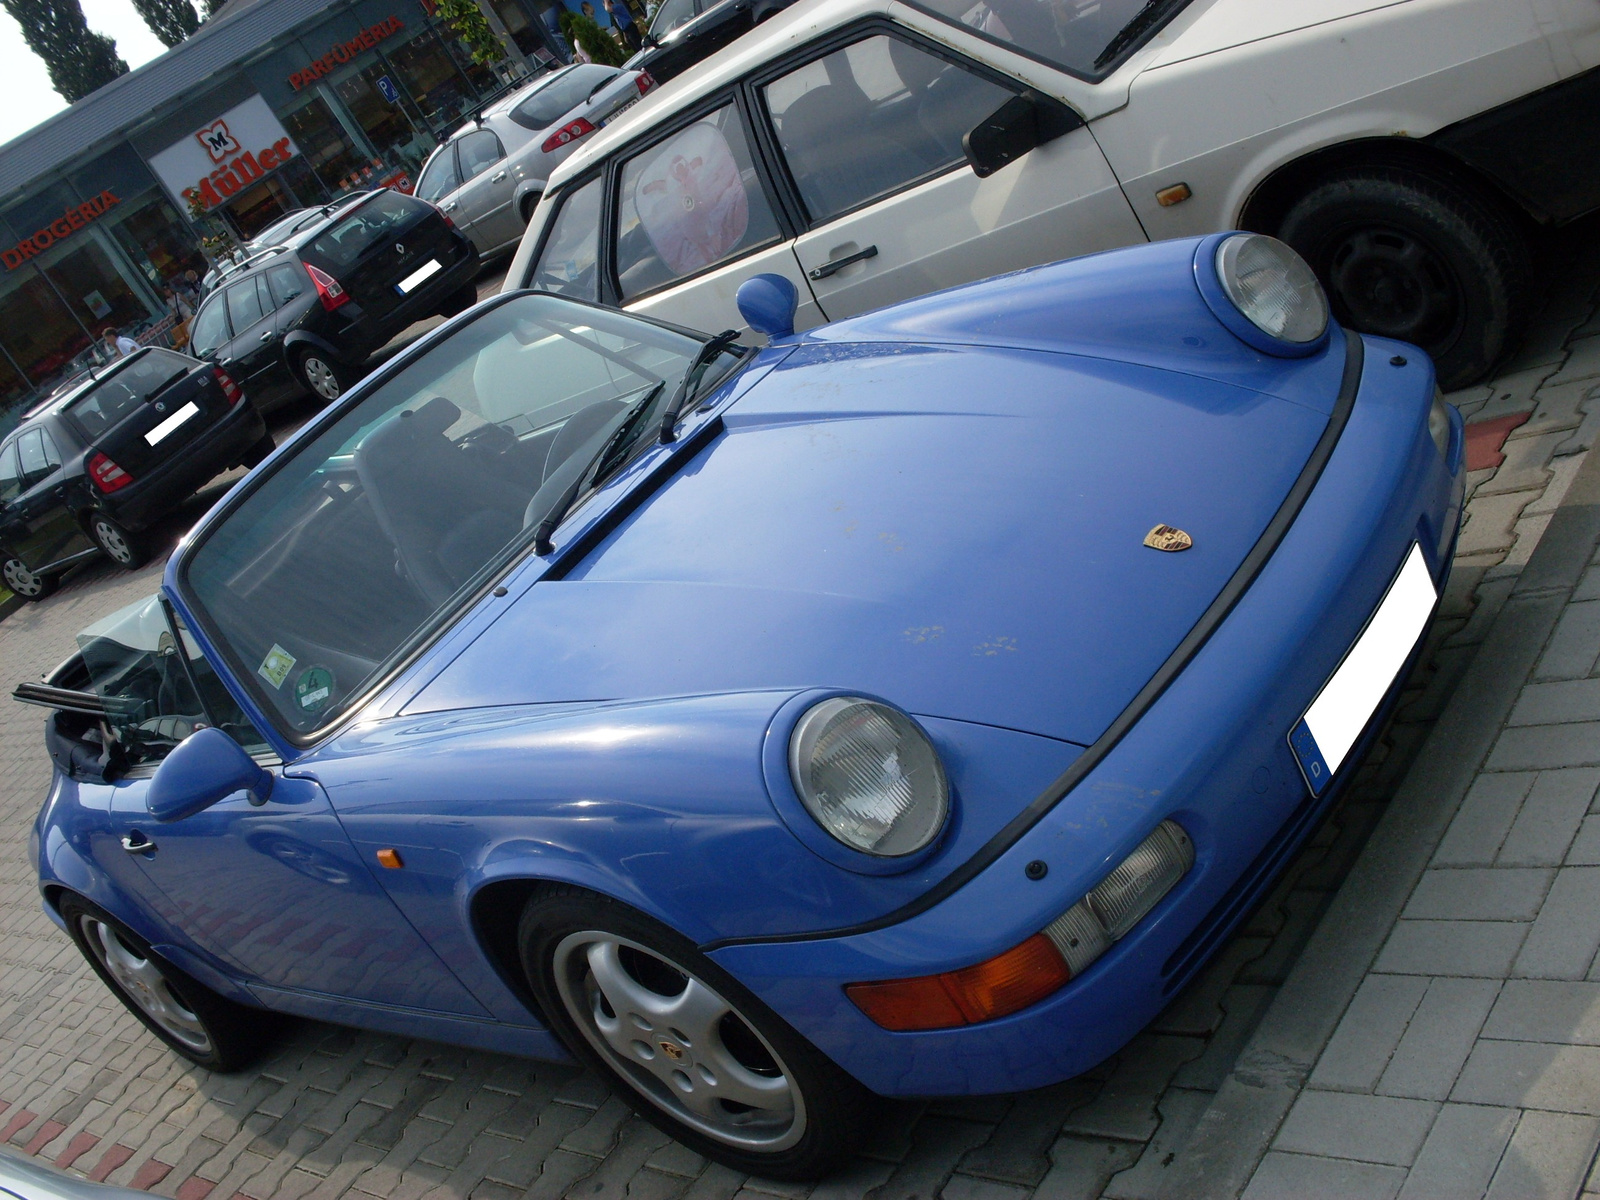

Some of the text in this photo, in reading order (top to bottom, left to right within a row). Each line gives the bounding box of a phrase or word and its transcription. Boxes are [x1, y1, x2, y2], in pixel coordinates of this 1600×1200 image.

[288, 14, 404, 91] PARFÜMÉRIA
[379, 80, 389, 97] P
[207, 131, 229, 152] M
[181, 136, 292, 210] Müller
[0, 189, 122, 270] DROGÉRIA
[1310, 761, 1321, 778] D
